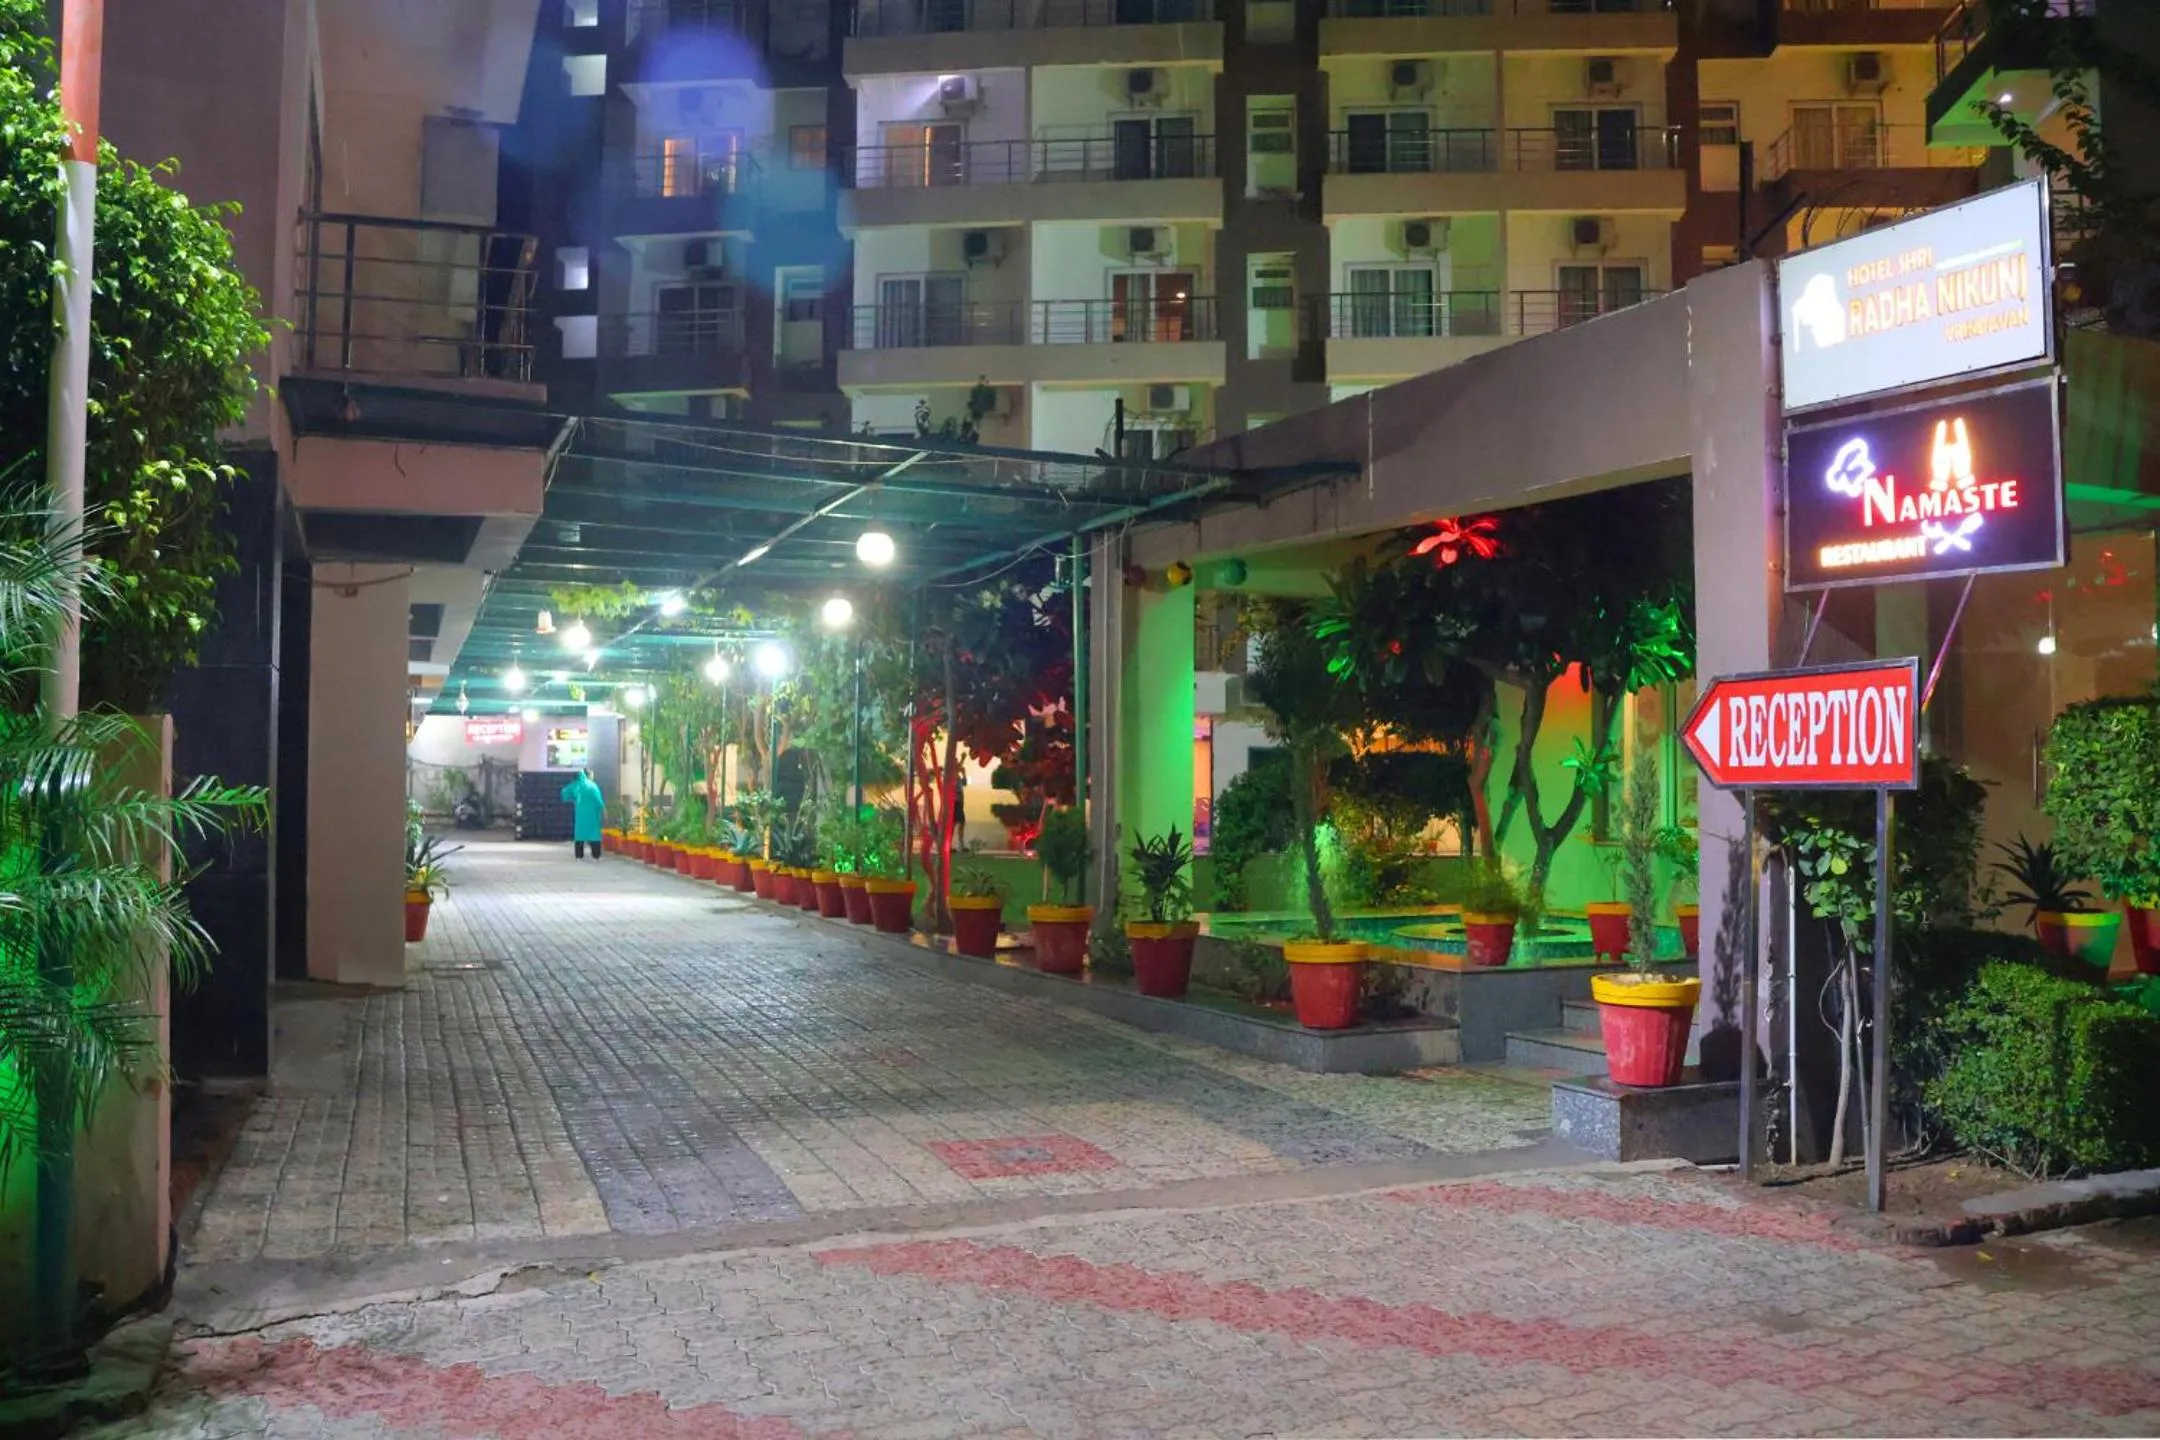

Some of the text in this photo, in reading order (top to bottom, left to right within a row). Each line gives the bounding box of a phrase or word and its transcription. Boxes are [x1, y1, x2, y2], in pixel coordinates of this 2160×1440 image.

[1848, 258, 1895, 287] HOTEL
[1849, 283, 1930, 336] RADHA
[1864, 475, 2019, 527] NAMASTE
[1729, 686, 1907, 768] RECEPTION
